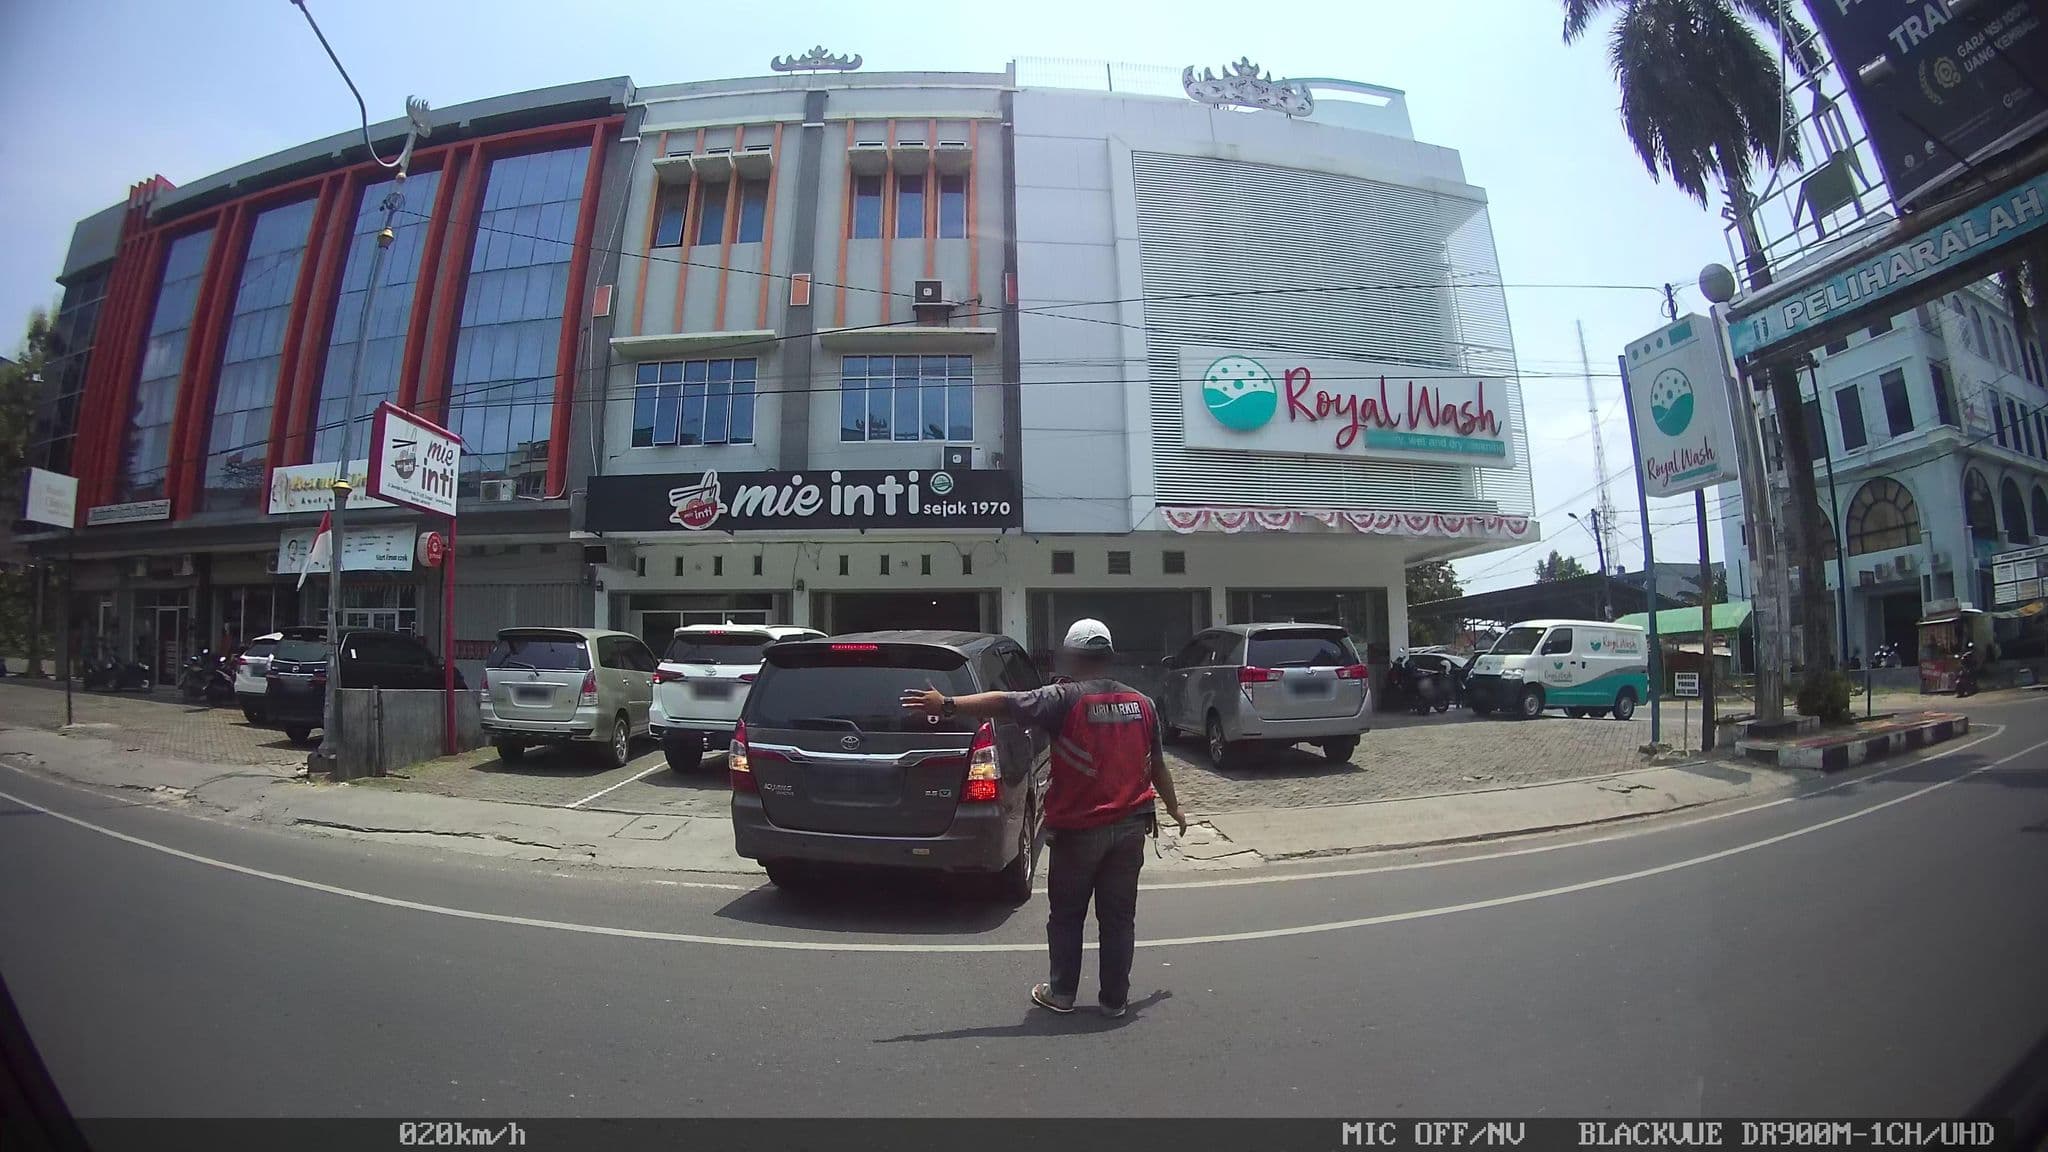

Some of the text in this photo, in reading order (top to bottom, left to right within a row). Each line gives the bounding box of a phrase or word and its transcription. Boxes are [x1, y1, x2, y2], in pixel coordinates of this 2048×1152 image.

[1963, 45, 1995, 72] UANG
[1782, 187, 2044, 331] PELIHARALAH
[1284, 367, 1502, 449] Royal Wash
[427, 440, 453, 466] mie
[1647, 456, 1680, 487] Royal
[1681, 435, 1716, 471] Wash
[422, 457, 454, 499] inti
[731, 471, 1011, 517] mie inti sejak 1970
